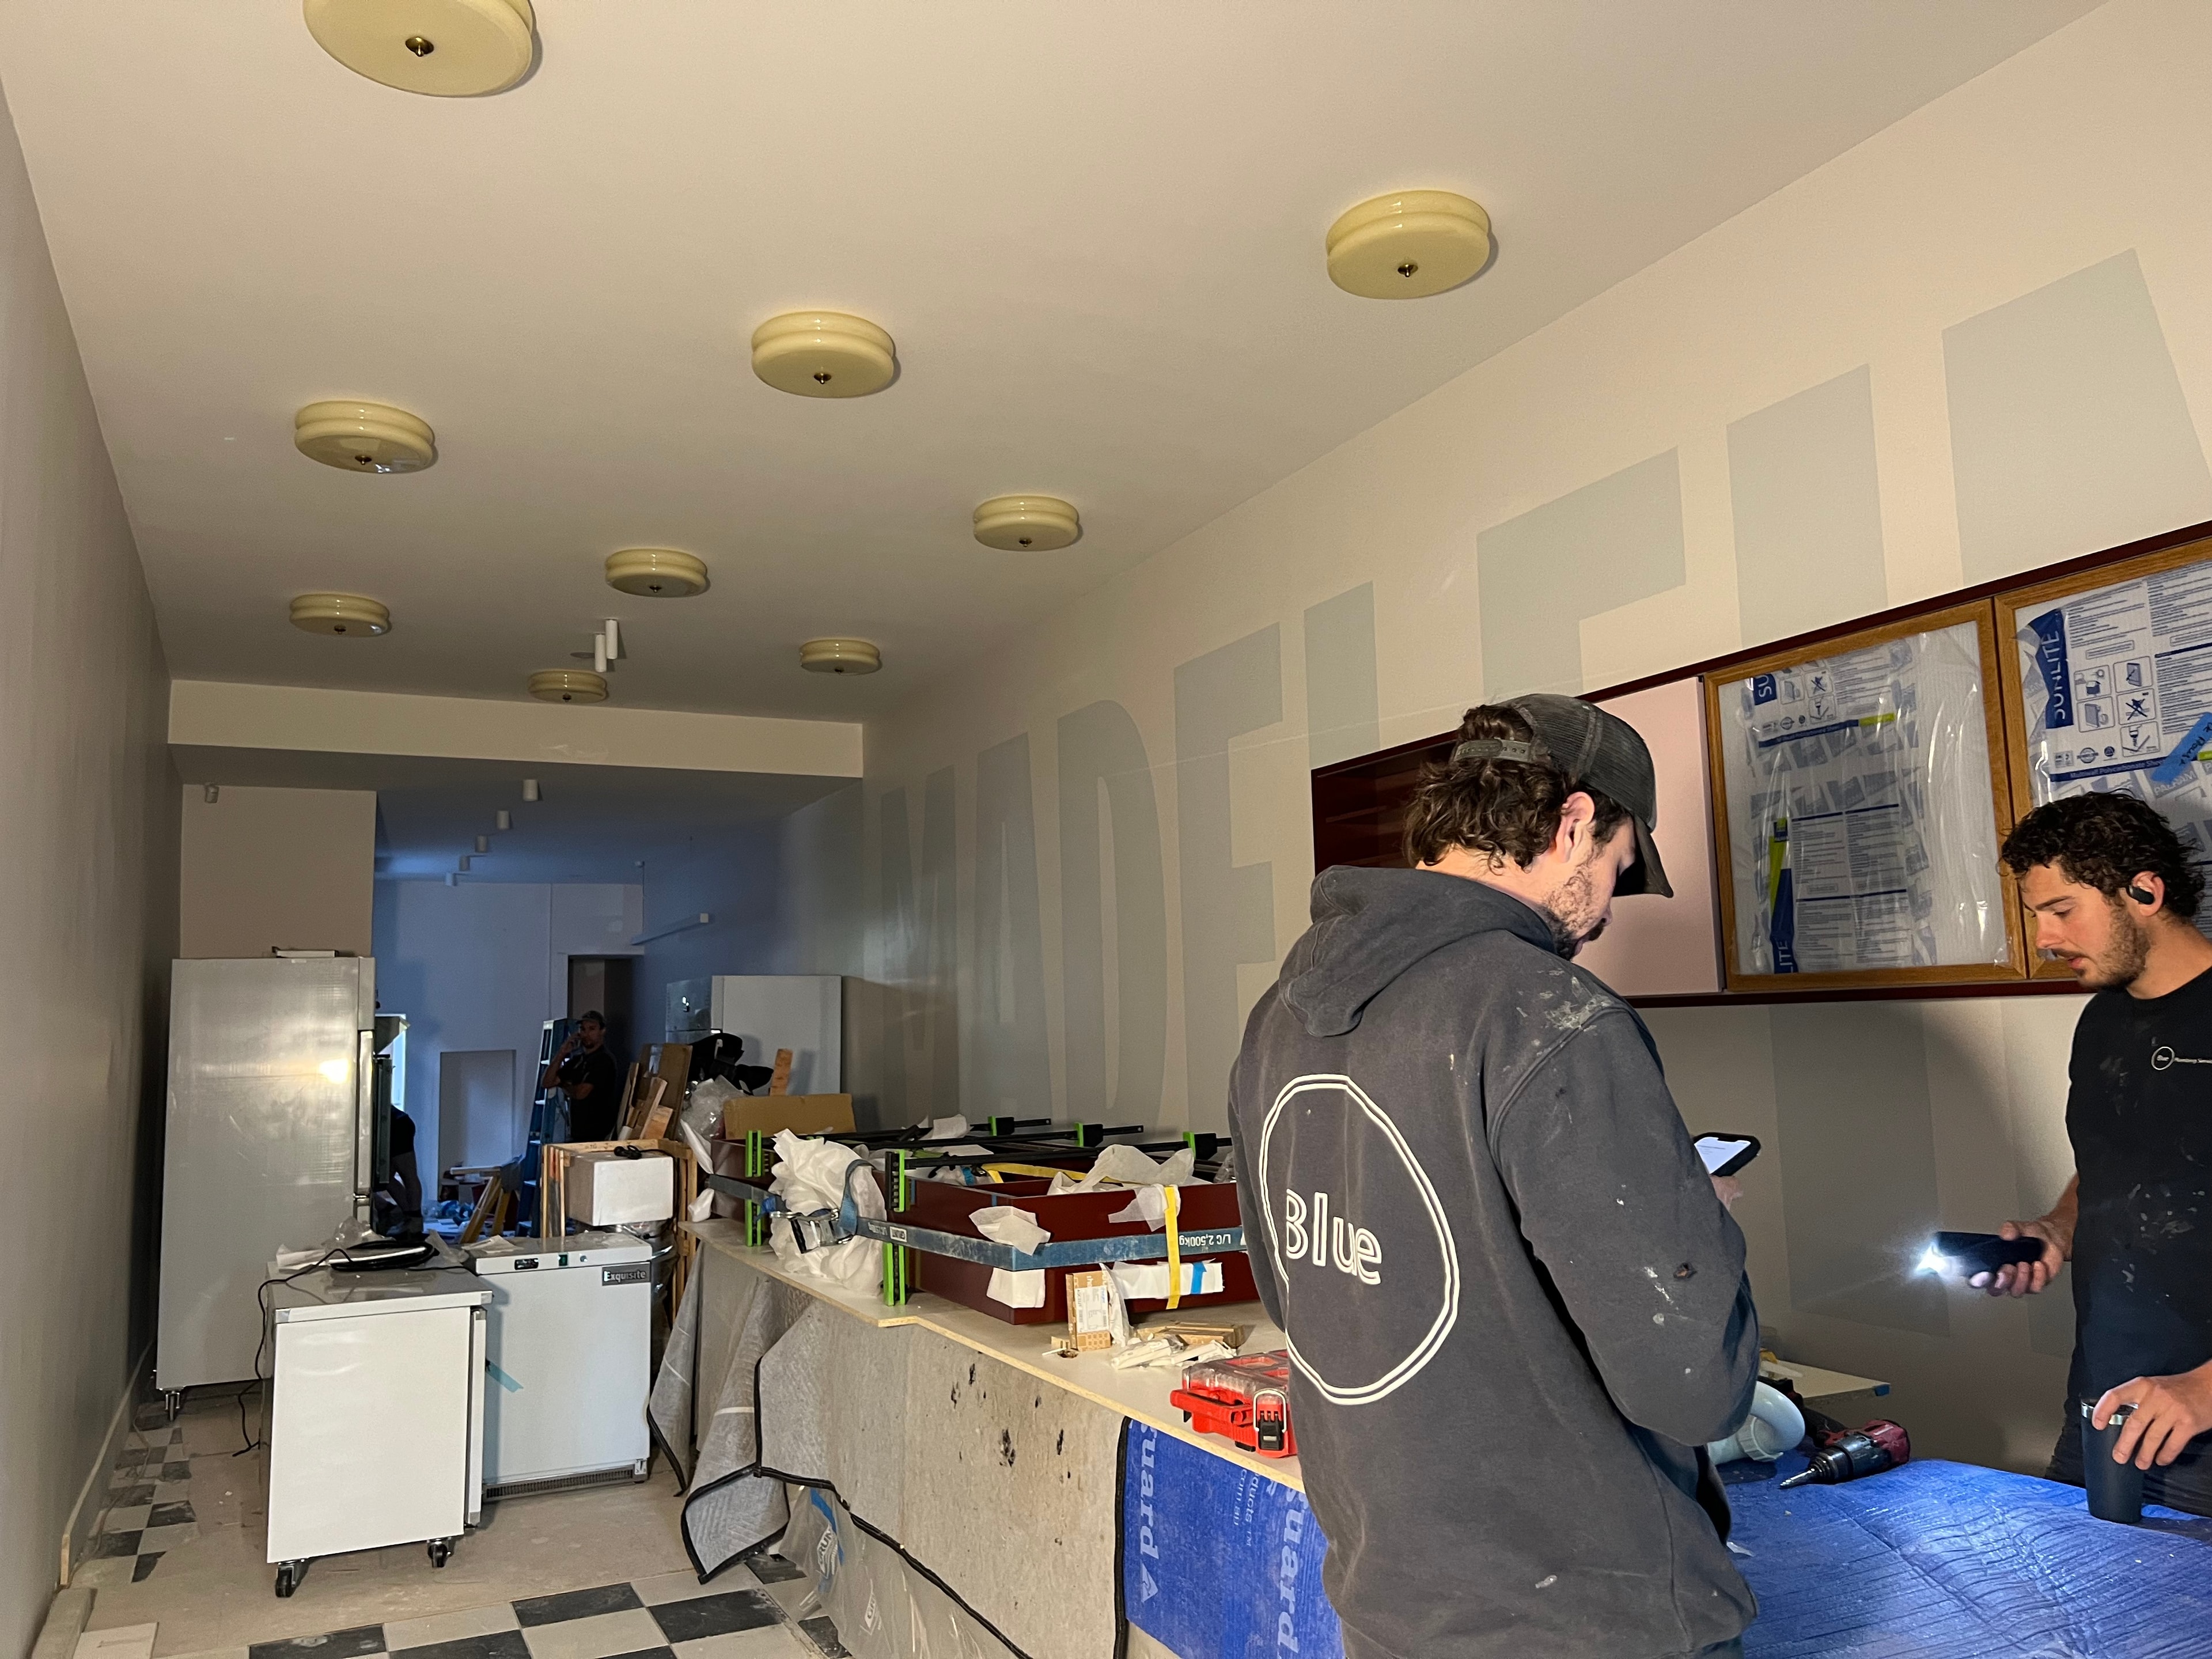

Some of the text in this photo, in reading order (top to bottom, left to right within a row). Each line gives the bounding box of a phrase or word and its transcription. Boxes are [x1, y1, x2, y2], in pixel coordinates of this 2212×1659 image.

[1179, 1233, 1231, 1247] L/C 2,500kg
[1286, 1188, 1382, 1285] Blue
[604, 1271, 646, 1283] Exquisite
[1245, 1472, 1261, 1522] ducts
